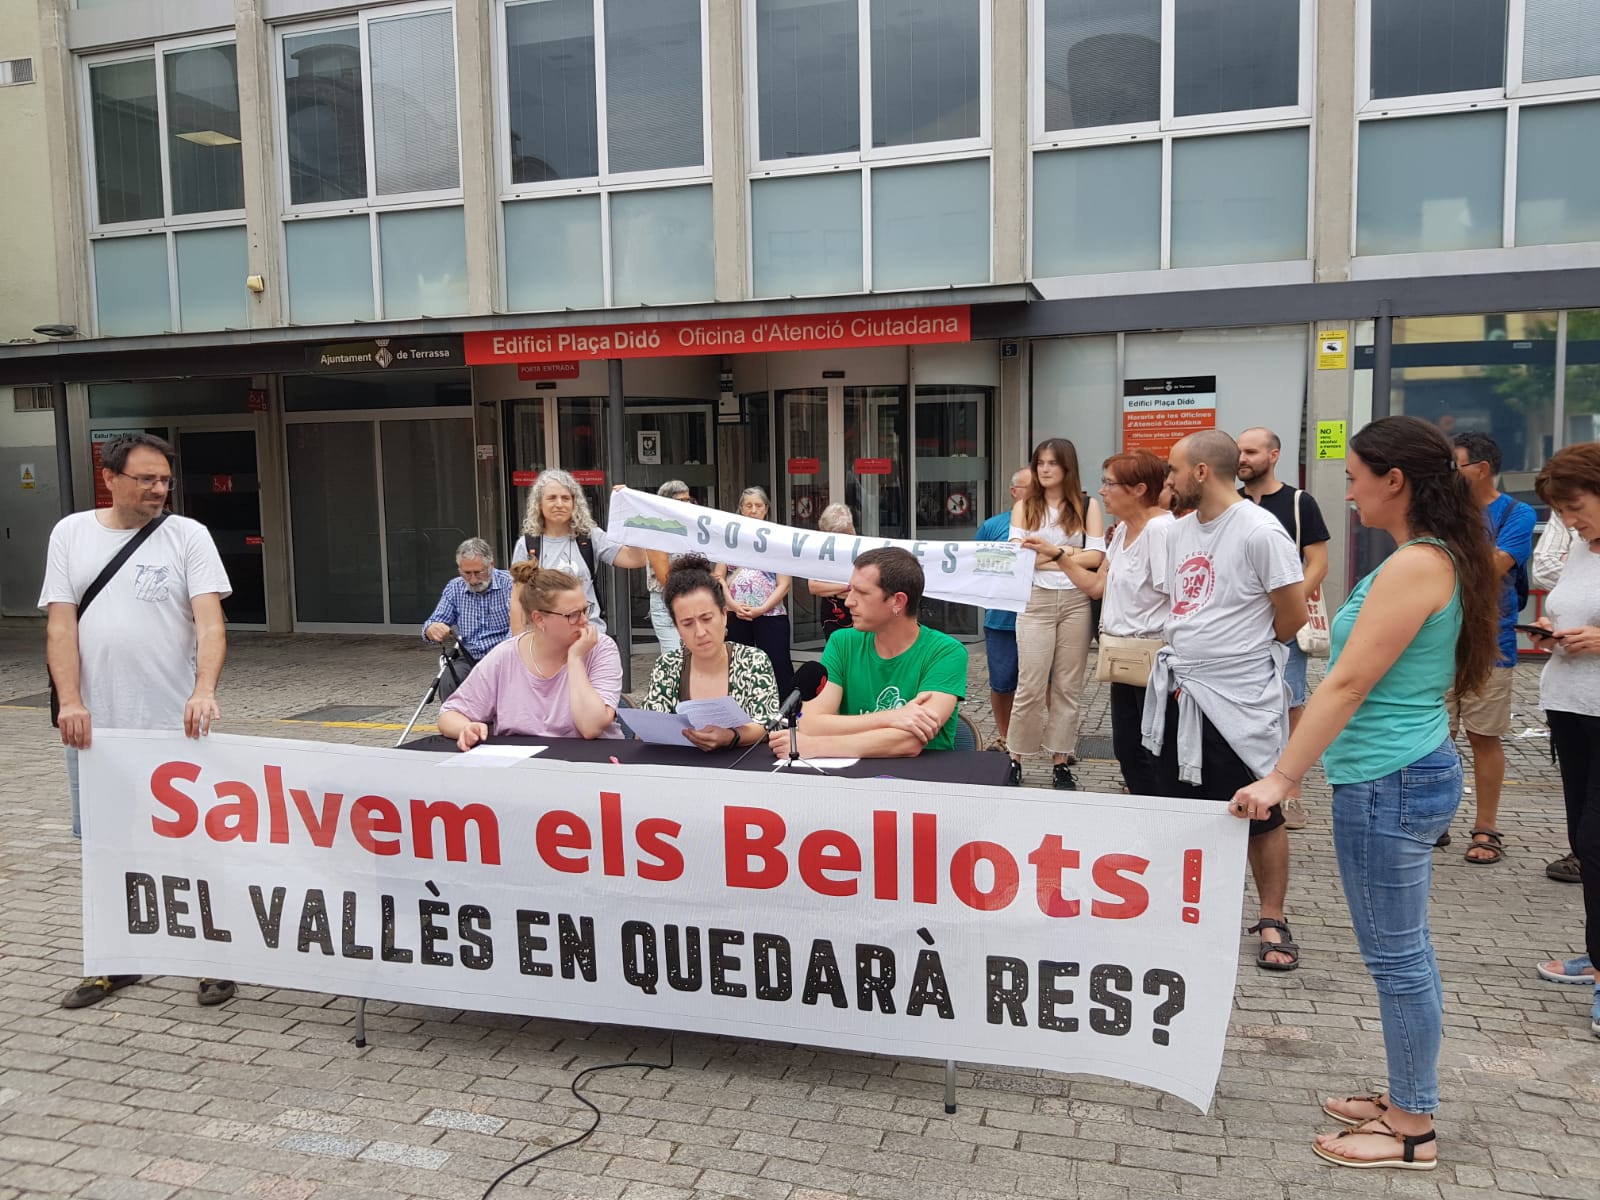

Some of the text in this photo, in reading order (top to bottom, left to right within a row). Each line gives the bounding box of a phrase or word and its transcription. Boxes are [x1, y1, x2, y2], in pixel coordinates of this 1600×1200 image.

[493, 314, 959, 355] Edifici Plaça Didó Oficina d'Atenció Ciutadana
[1005, 343, 1014, 357] 5
[320, 348, 450, 364] Ajuntament de Terrassa
[1128, 400, 1152, 408] Edifici
[1154, 399, 1175, 407] Plaça
[696, 515, 772, 553] SOS
[150, 761, 1203, 924] Salvem els Bellots !
[125, 871, 1187, 1047] DEL VALLÈS EN QUEDARÀ RES?
